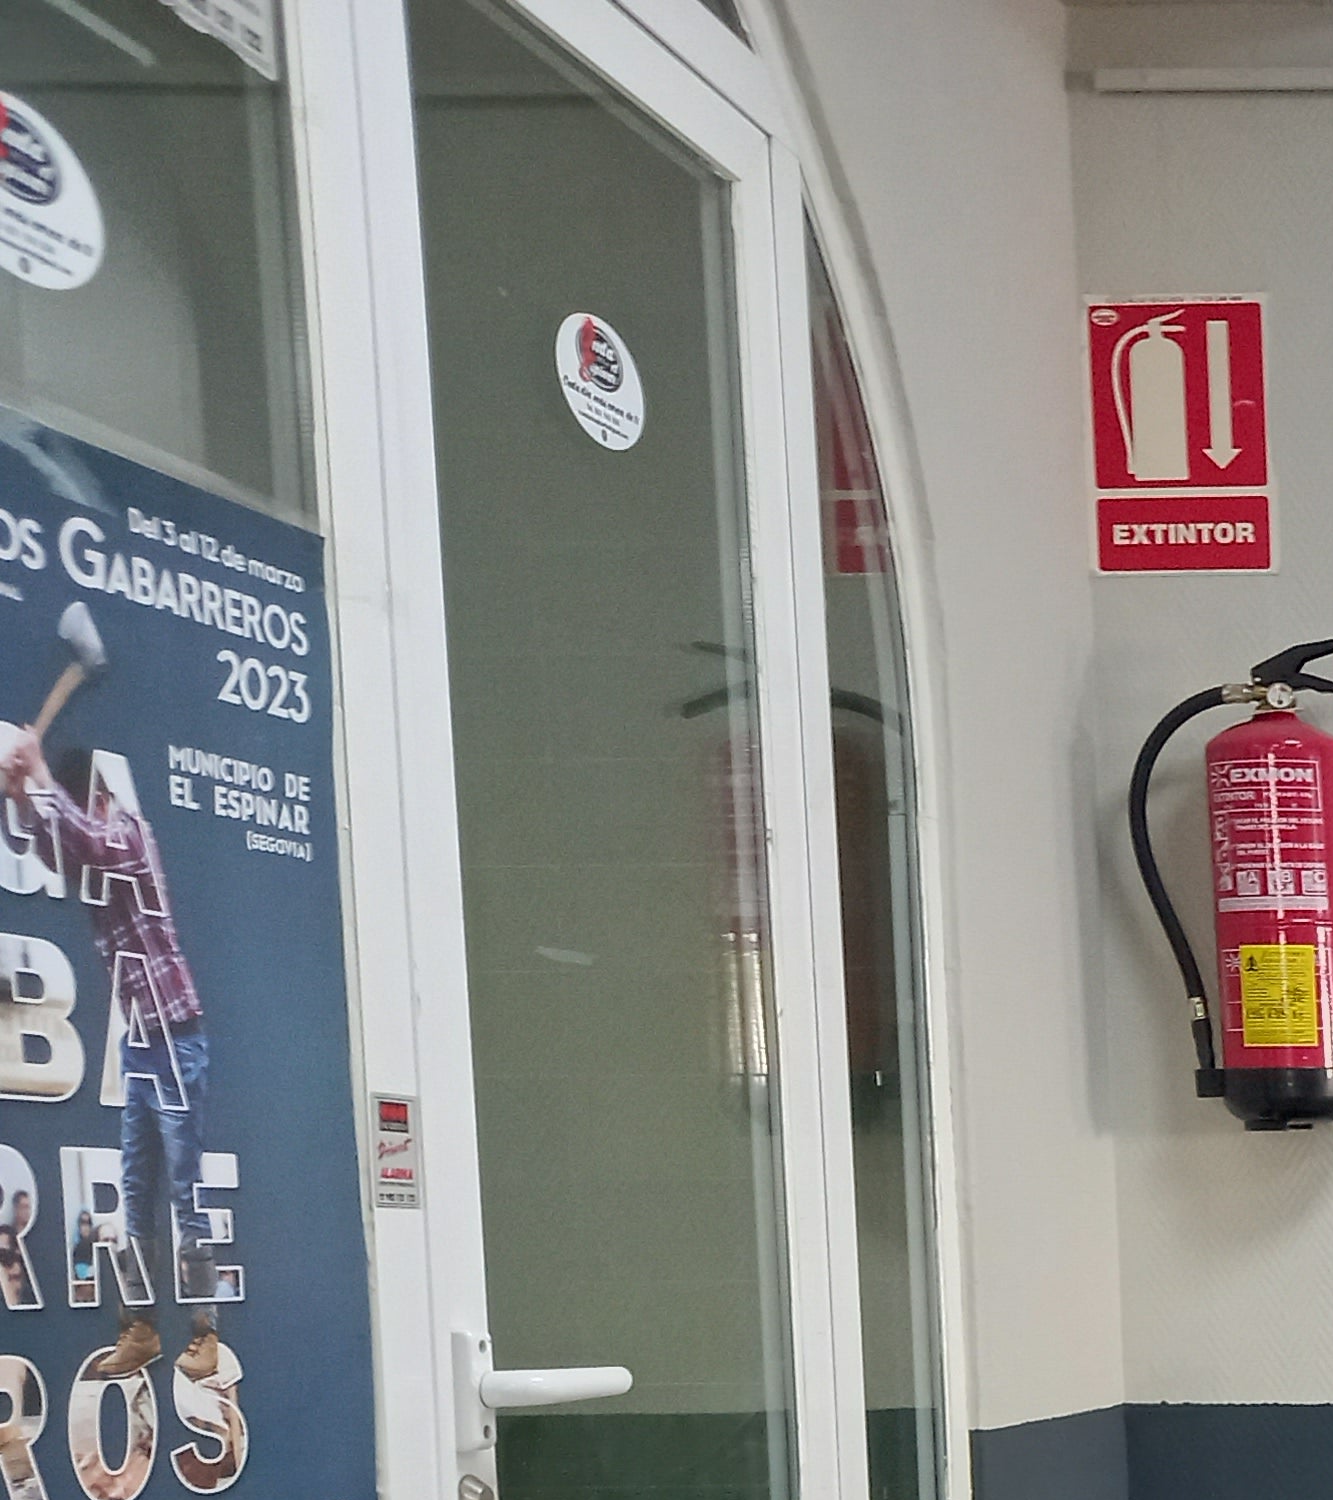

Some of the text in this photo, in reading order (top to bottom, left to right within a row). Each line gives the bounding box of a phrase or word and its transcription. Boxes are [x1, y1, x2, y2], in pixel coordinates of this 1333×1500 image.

[127, 507, 305, 592] Del 3 al 12 de marzo
[1112, 522, 1255, 545] EXTINTOR
[58, 516, 310, 656] GABARREROS
[216, 650, 311, 724] 2023
[168, 745, 310, 801] MUNICIPIO DE
[170, 775, 310, 835] EL ESPINAR
[246, 830, 313, 862] (SEGOVIA)
